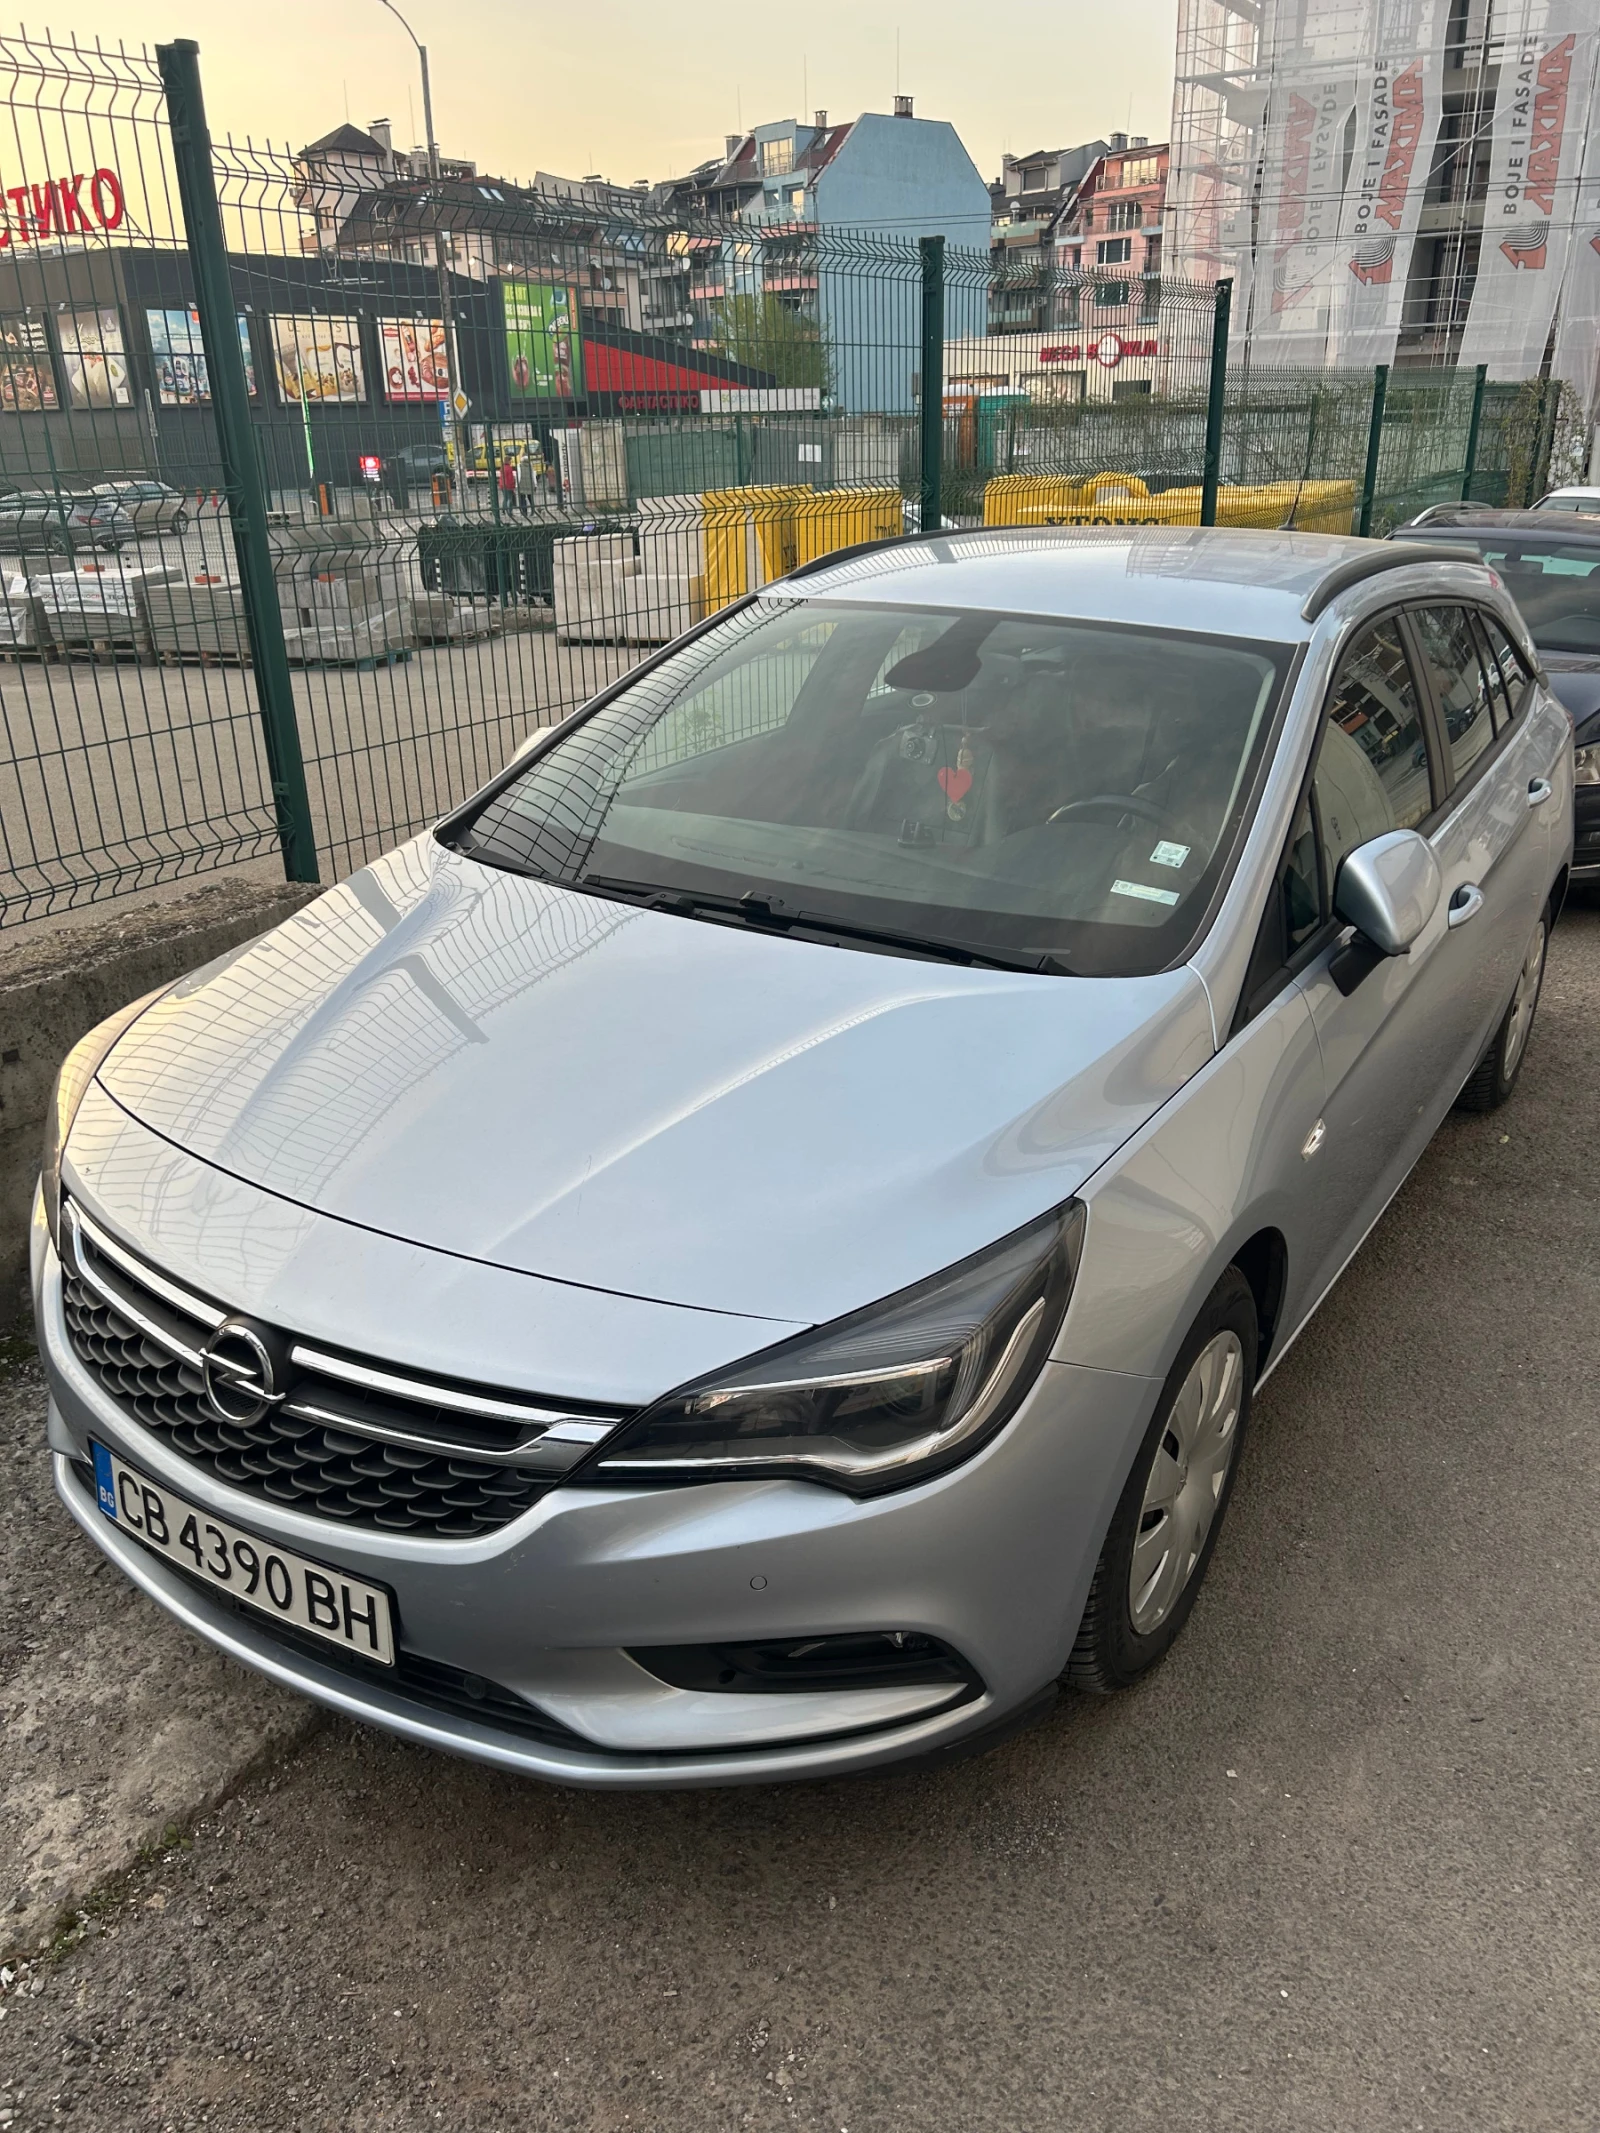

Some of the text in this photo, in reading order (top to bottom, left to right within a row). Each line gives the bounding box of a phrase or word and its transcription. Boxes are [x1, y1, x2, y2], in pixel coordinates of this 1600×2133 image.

[1354, 178, 1376, 234] BOJE
[1371, 60, 1389, 149] FASADE
[1374, 56, 1424, 231] MAXIMA
[1512, 35, 1538, 128] FASADE
[1523, 33, 1576, 215] MAXIMA
[1503, 157, 1523, 215] BOJE
[1039, 332, 1159, 369] MEGA BOWLIN
[100, 1485, 115, 1509] BG
[118, 1470, 379, 1651] CB 4390 BH
